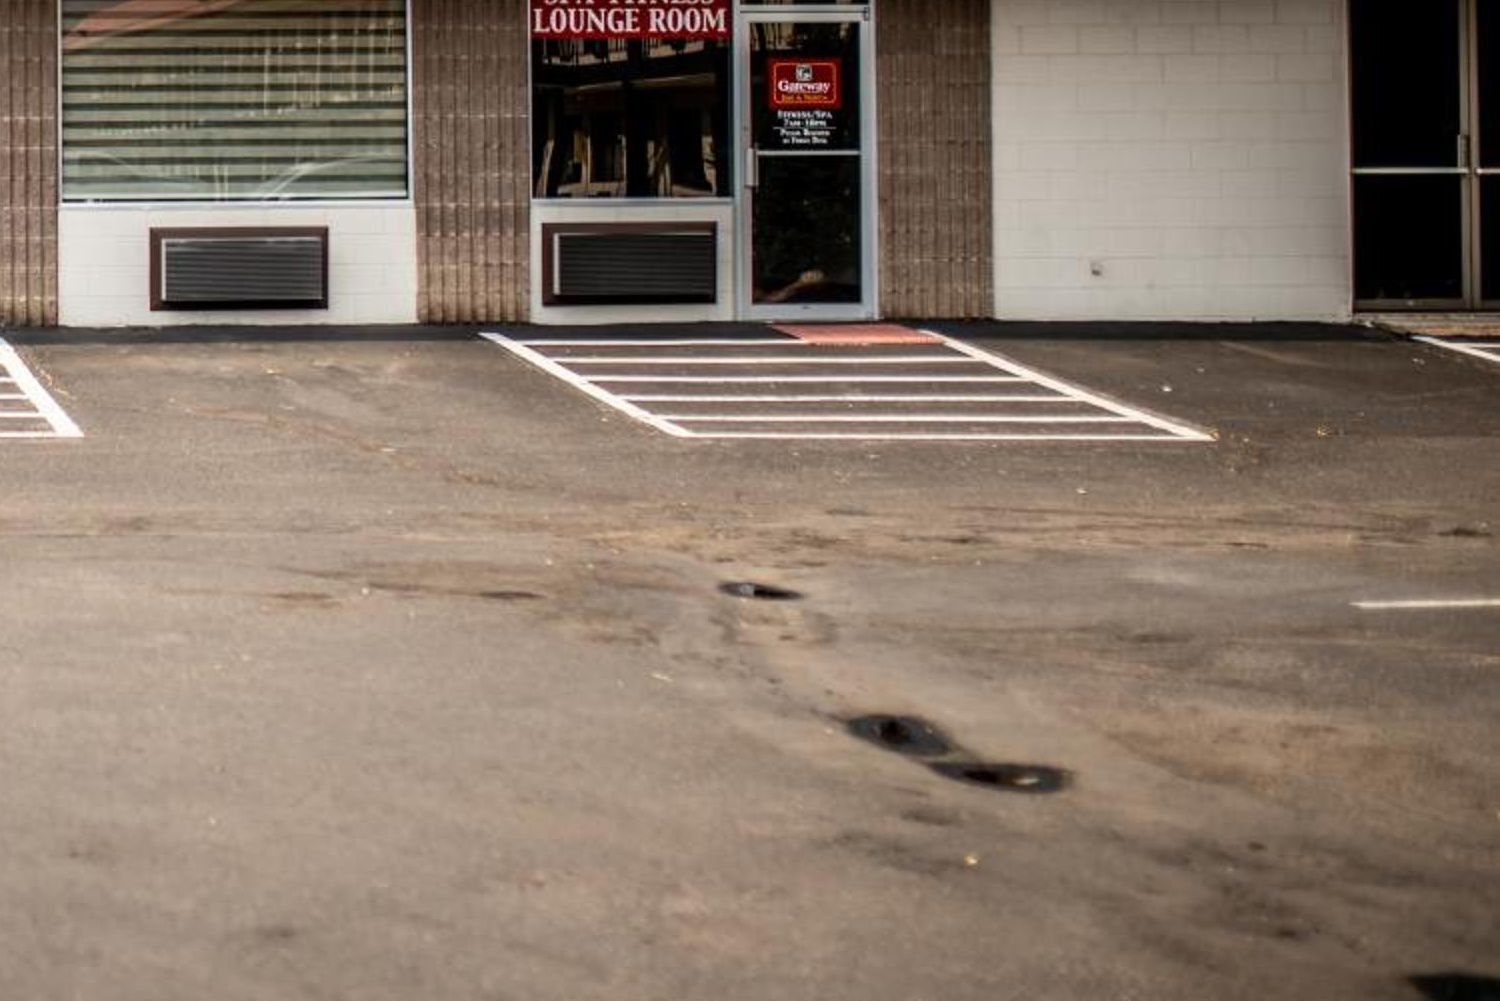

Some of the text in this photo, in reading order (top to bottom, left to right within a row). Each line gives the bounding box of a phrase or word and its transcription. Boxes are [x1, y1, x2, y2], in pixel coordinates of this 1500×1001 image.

[533, 7, 728, 33] LOUNGE ROOM
[777, 80, 831, 94] Gateway
